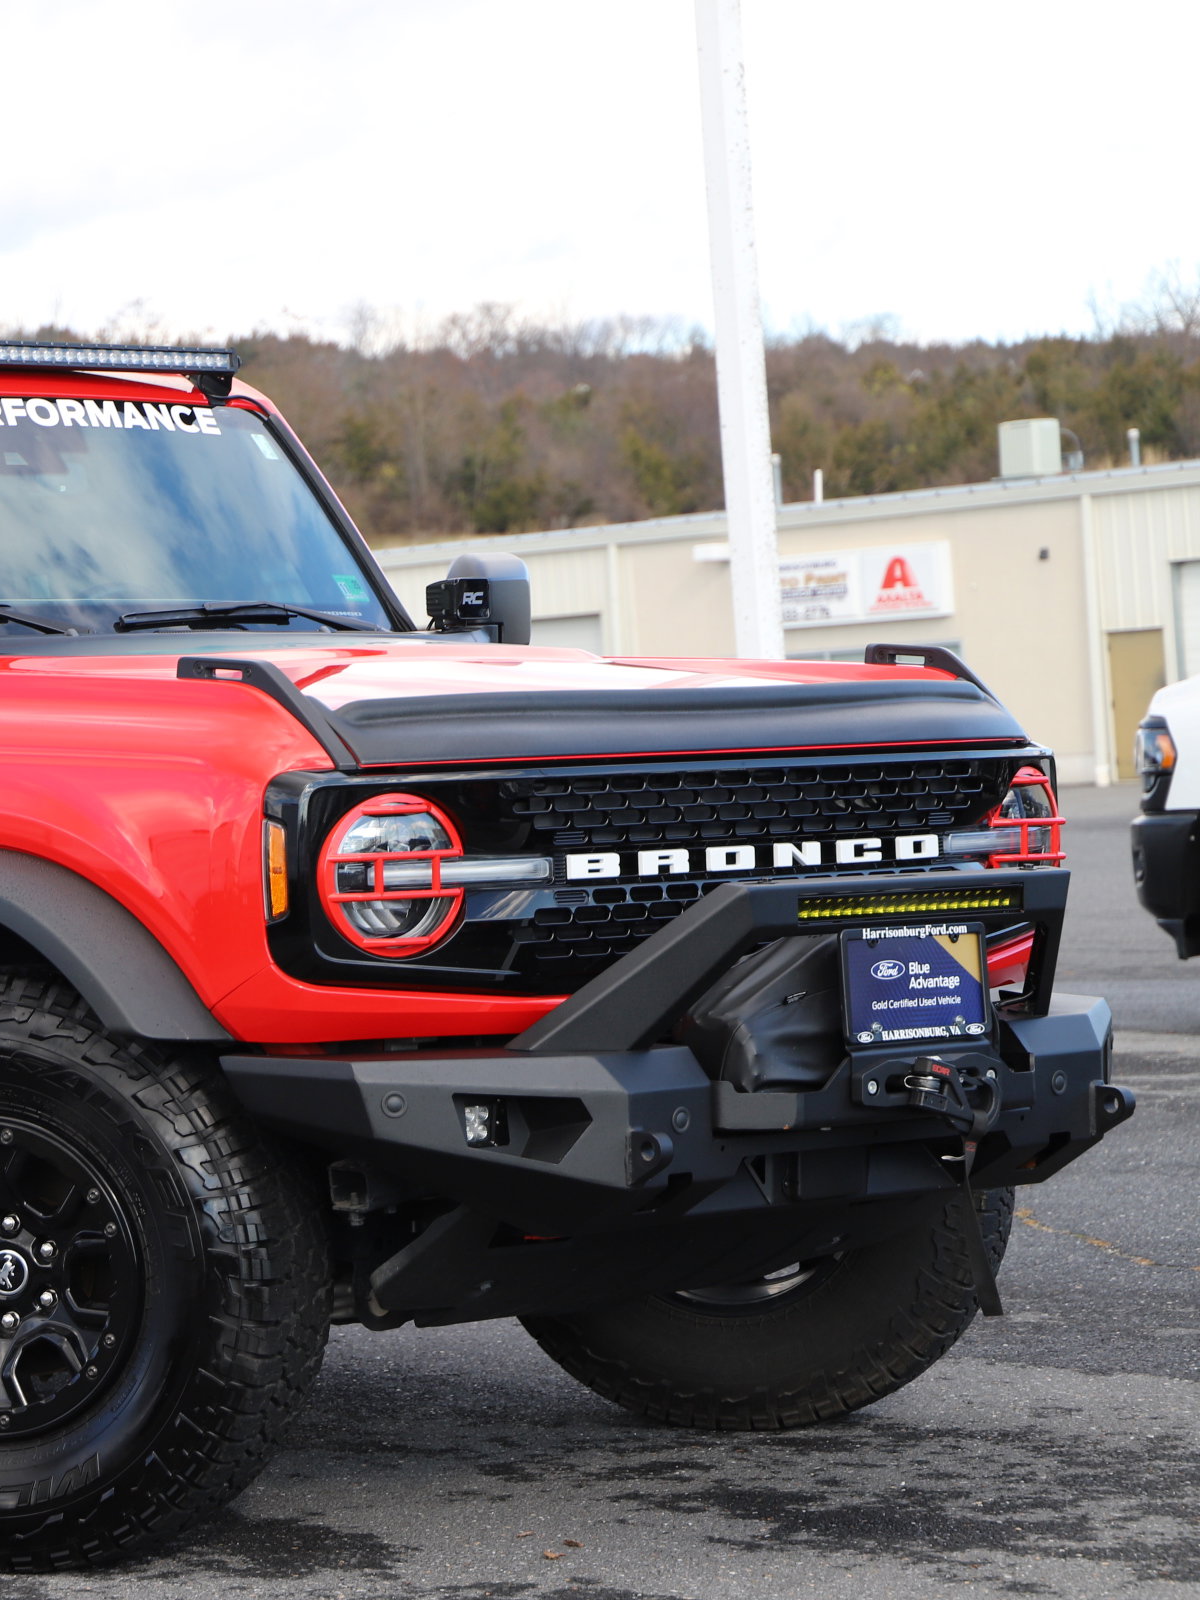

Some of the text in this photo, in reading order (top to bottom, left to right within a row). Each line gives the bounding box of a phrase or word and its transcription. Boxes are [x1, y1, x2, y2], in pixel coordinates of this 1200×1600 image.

[461, 591, 484, 605] RC
[566, 833, 940, 880] BRONCO
[862, 923, 968, 940] HarrisonburgFord.com
[877, 961, 899, 977] Ford
[908, 961, 931, 975] Blue
[908, 975, 960, 990] Advantage
[871, 995, 962, 1011] Gold Certified Used Vehicle
[881, 1025, 961, 1041] HARRISONBURG, VA
